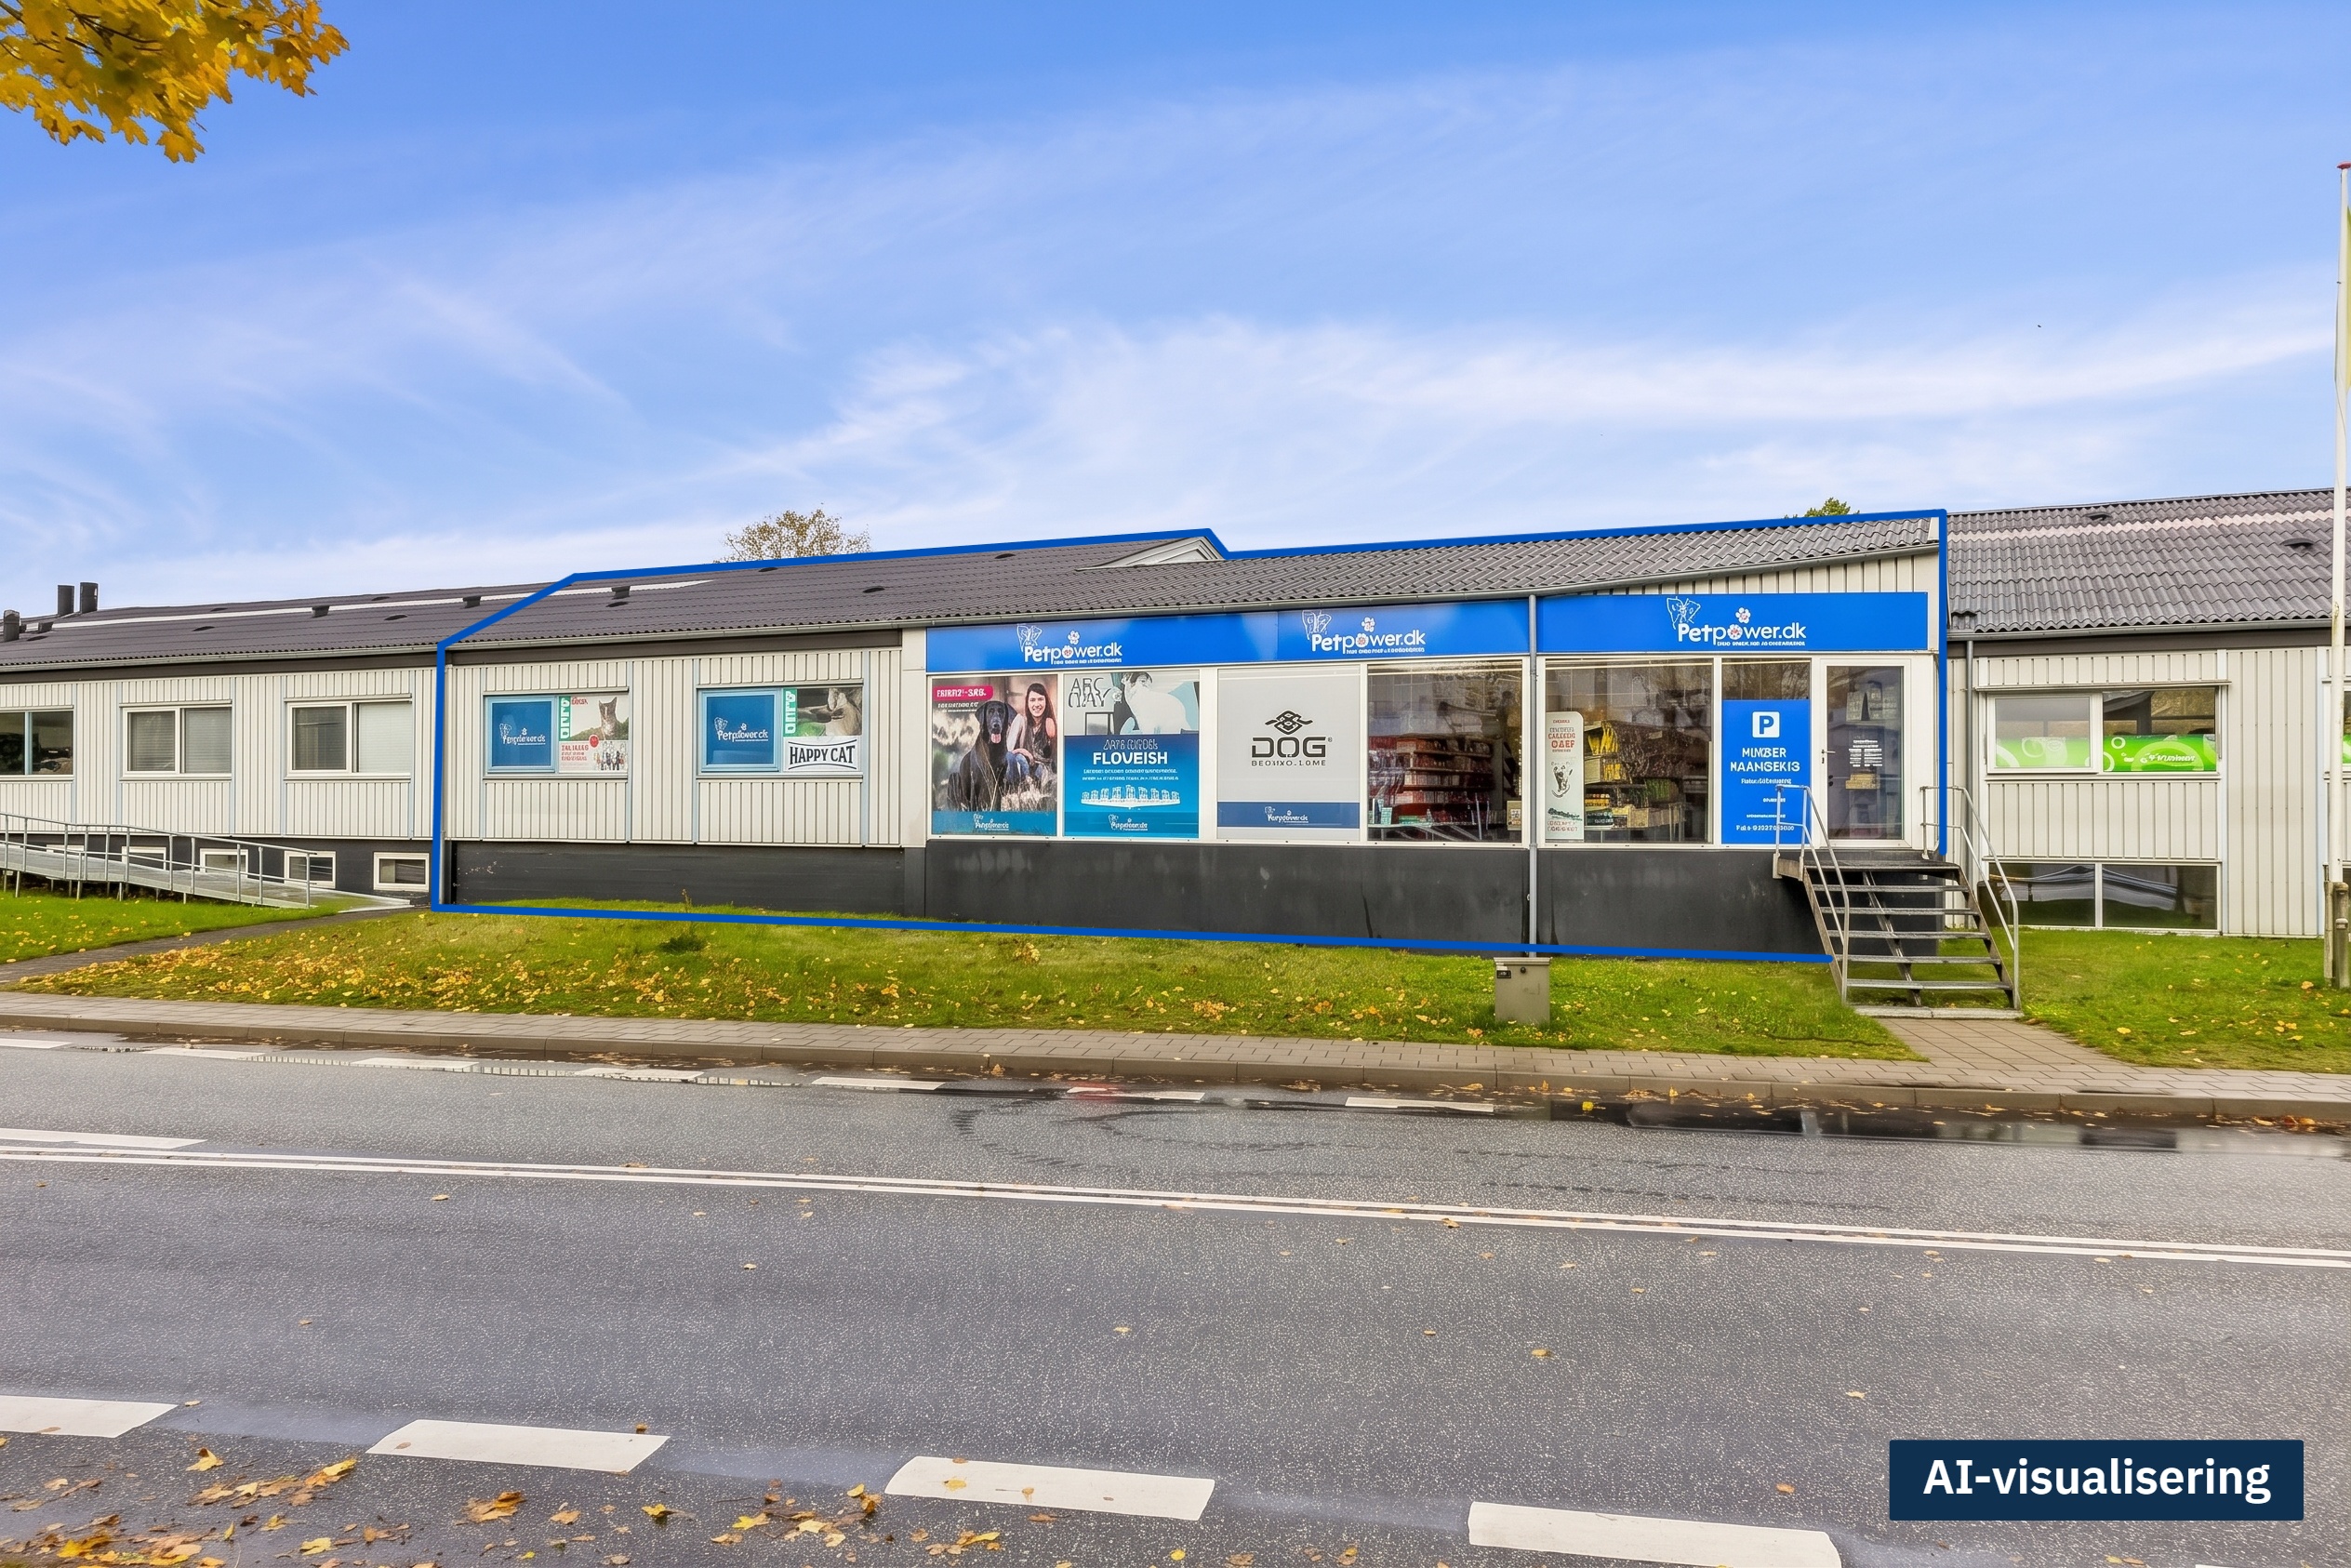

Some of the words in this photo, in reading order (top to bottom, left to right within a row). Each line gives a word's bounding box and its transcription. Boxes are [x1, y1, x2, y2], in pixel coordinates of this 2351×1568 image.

[1311, 630, 1426, 654] Petpower.dk
[1678, 622, 1807, 645] Petpower.dk
[1024, 642, 1123, 664] Petpower.dk
[1759, 715, 1774, 735] P
[790, 746, 829, 765] HAPPY
[830, 744, 856, 764] CAT
[1093, 751, 1168, 765] FLOVEISH
[1251, 737, 1326, 758] DOG
